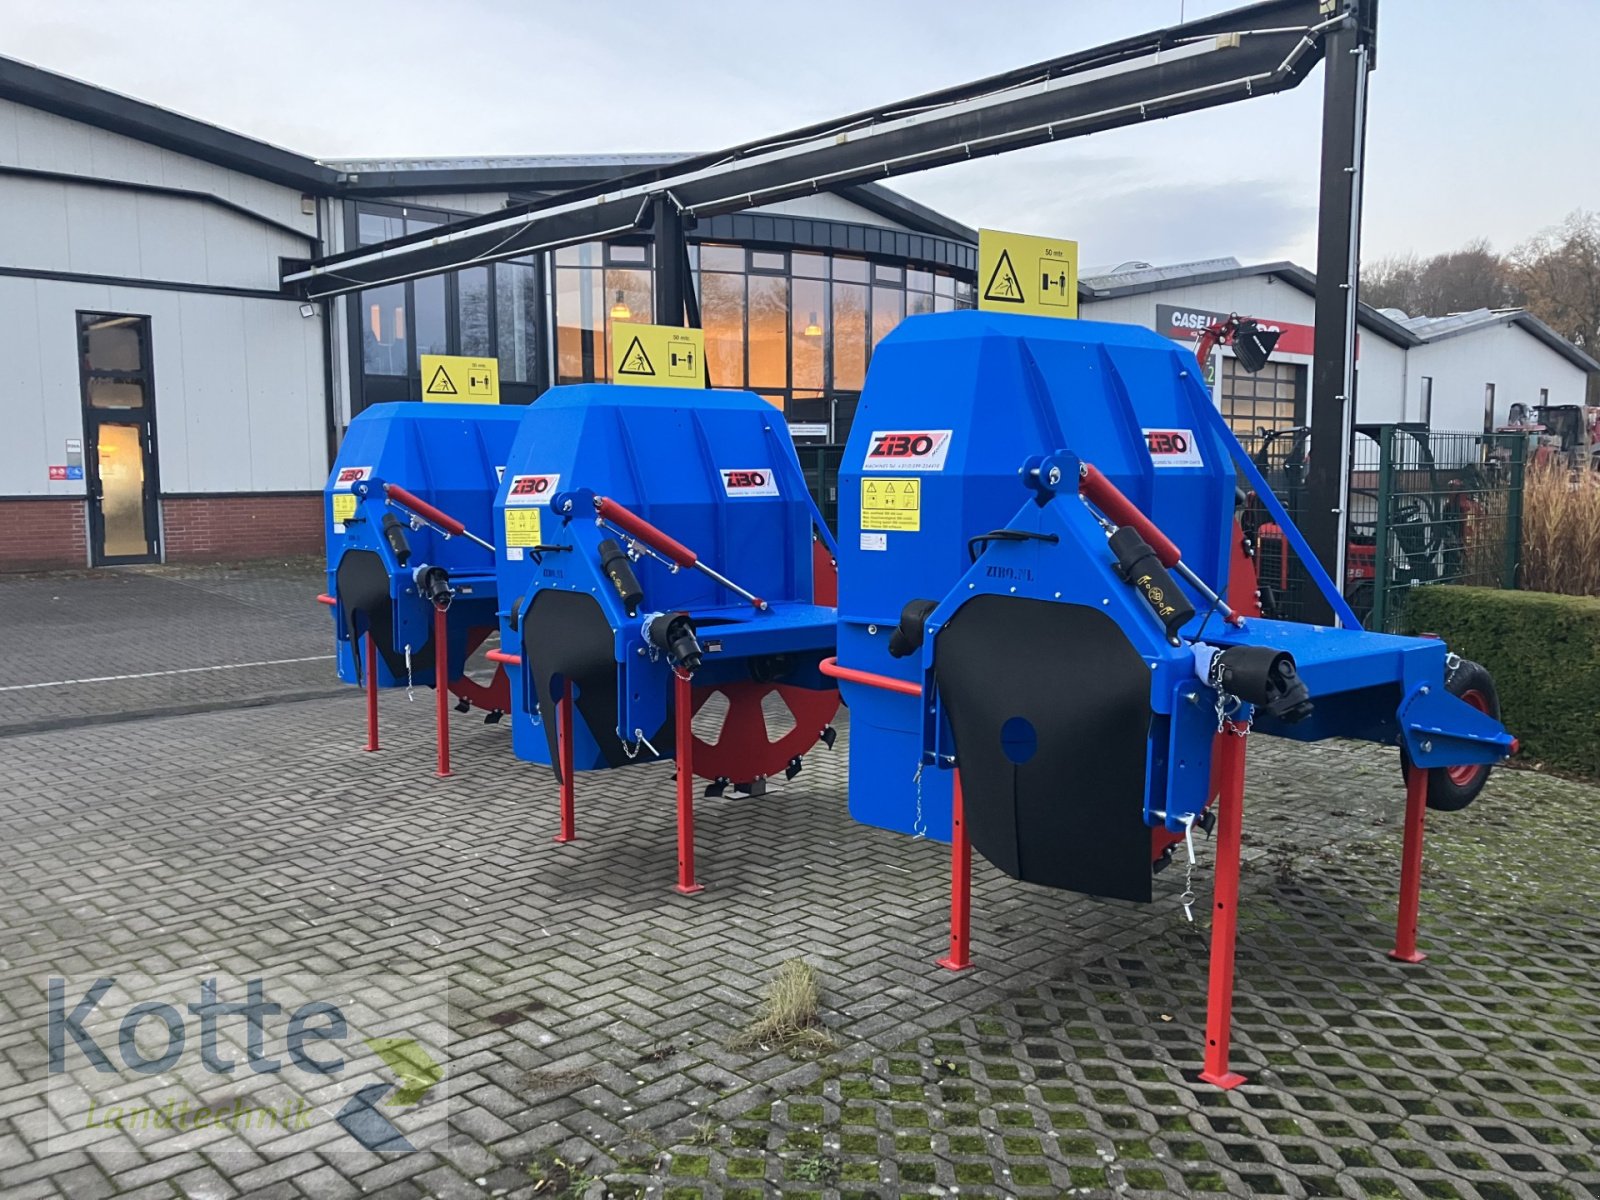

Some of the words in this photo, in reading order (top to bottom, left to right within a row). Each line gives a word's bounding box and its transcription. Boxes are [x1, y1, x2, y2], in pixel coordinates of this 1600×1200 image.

[1045, 248, 1053, 256] 50
[1171, 311, 1205, 329] CASE
[871, 436, 933, 456] ZIBO
[511, 478, 549, 494] ZIBO
[723, 471, 765, 488] ZIBO
